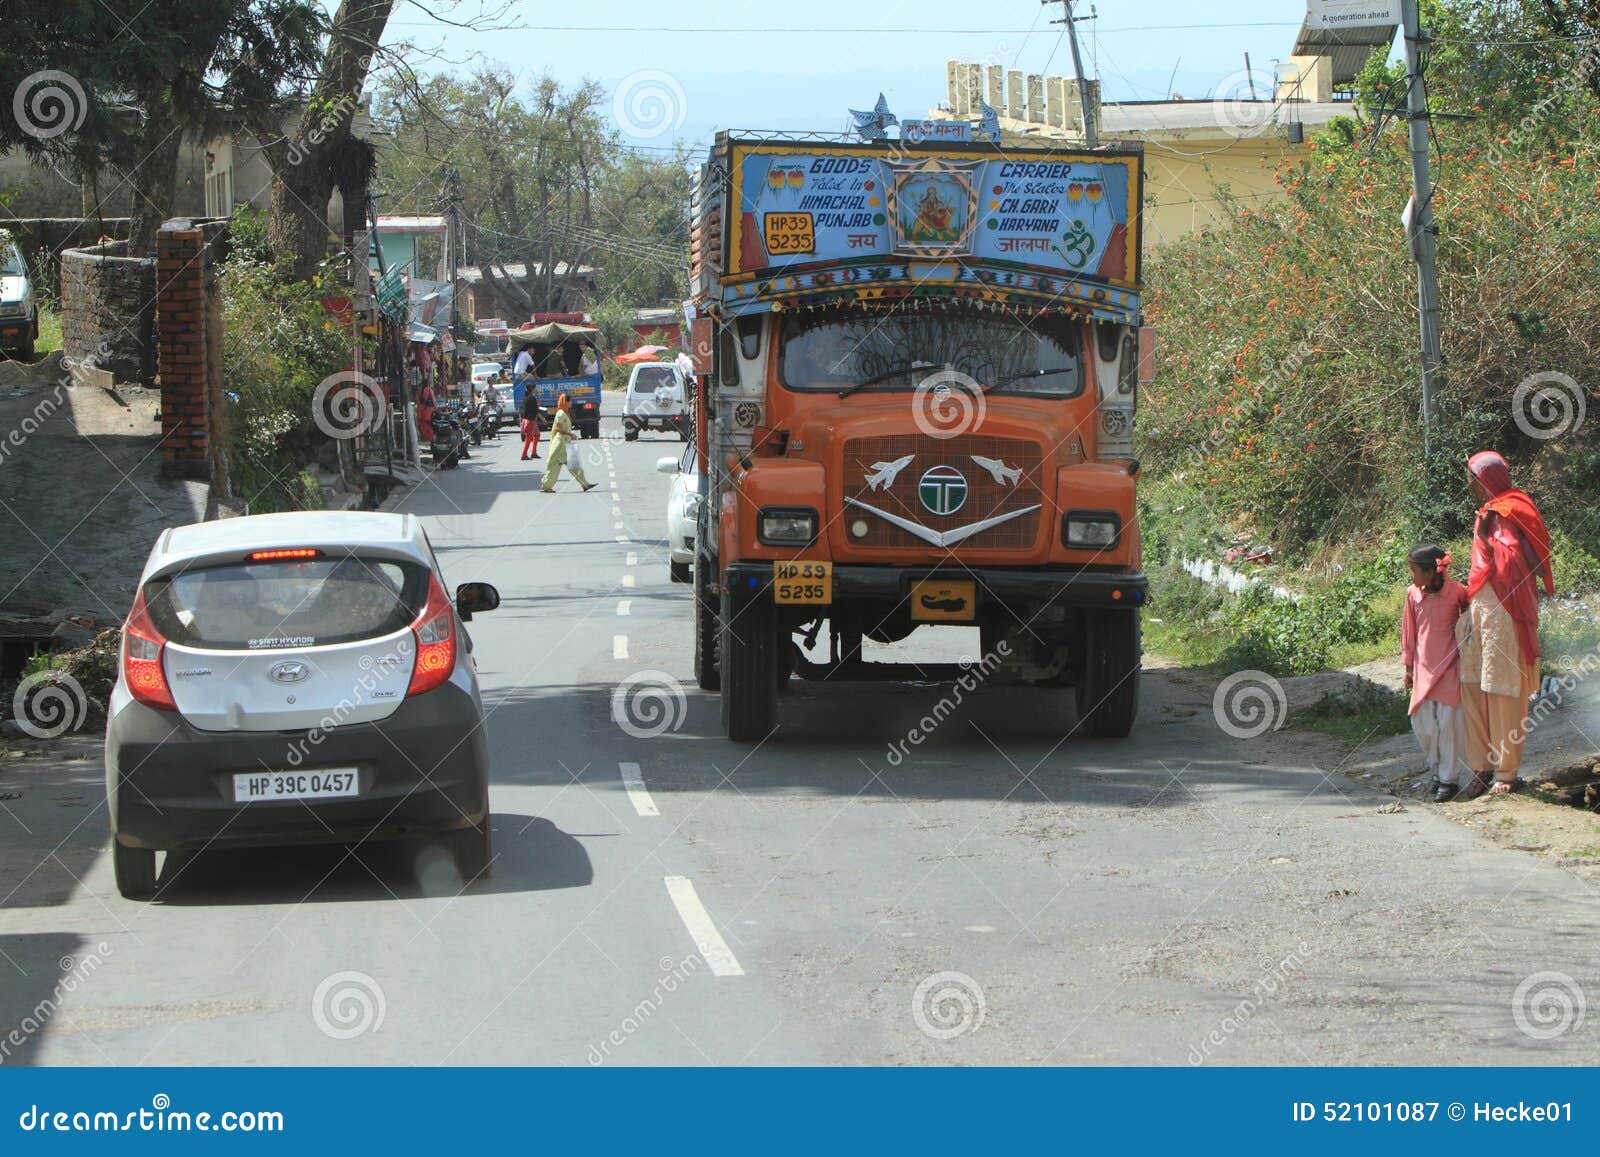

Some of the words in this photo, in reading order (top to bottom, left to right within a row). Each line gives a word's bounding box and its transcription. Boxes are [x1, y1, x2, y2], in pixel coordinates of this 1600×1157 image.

[1329, 12, 1366, 22] generation
[1368, 10, 1389, 18] ahead
[809, 159, 872, 173] GOODS
[1000, 164, 1071, 178] CARRIER
[799, 195, 864, 209] HIMACHAL
[999, 199, 1059, 214] CH.GARH
[815, 213, 872, 227] PUNJAB
[999, 218, 1059, 232] HARYANA
[770, 234, 812, 249] 5235
[848, 234, 878, 248] जय
[998, 238, 1051, 252] जालपा
[779, 566, 797, 578] HP
[803, 566, 825, 578] 39
[779, 585, 824, 599] 5235
[280, 636, 315, 644] HYUNDAI
[249, 778, 270, 796] HP
[275, 776, 306, 794] 39C
[311, 773, 354, 792] 0457
